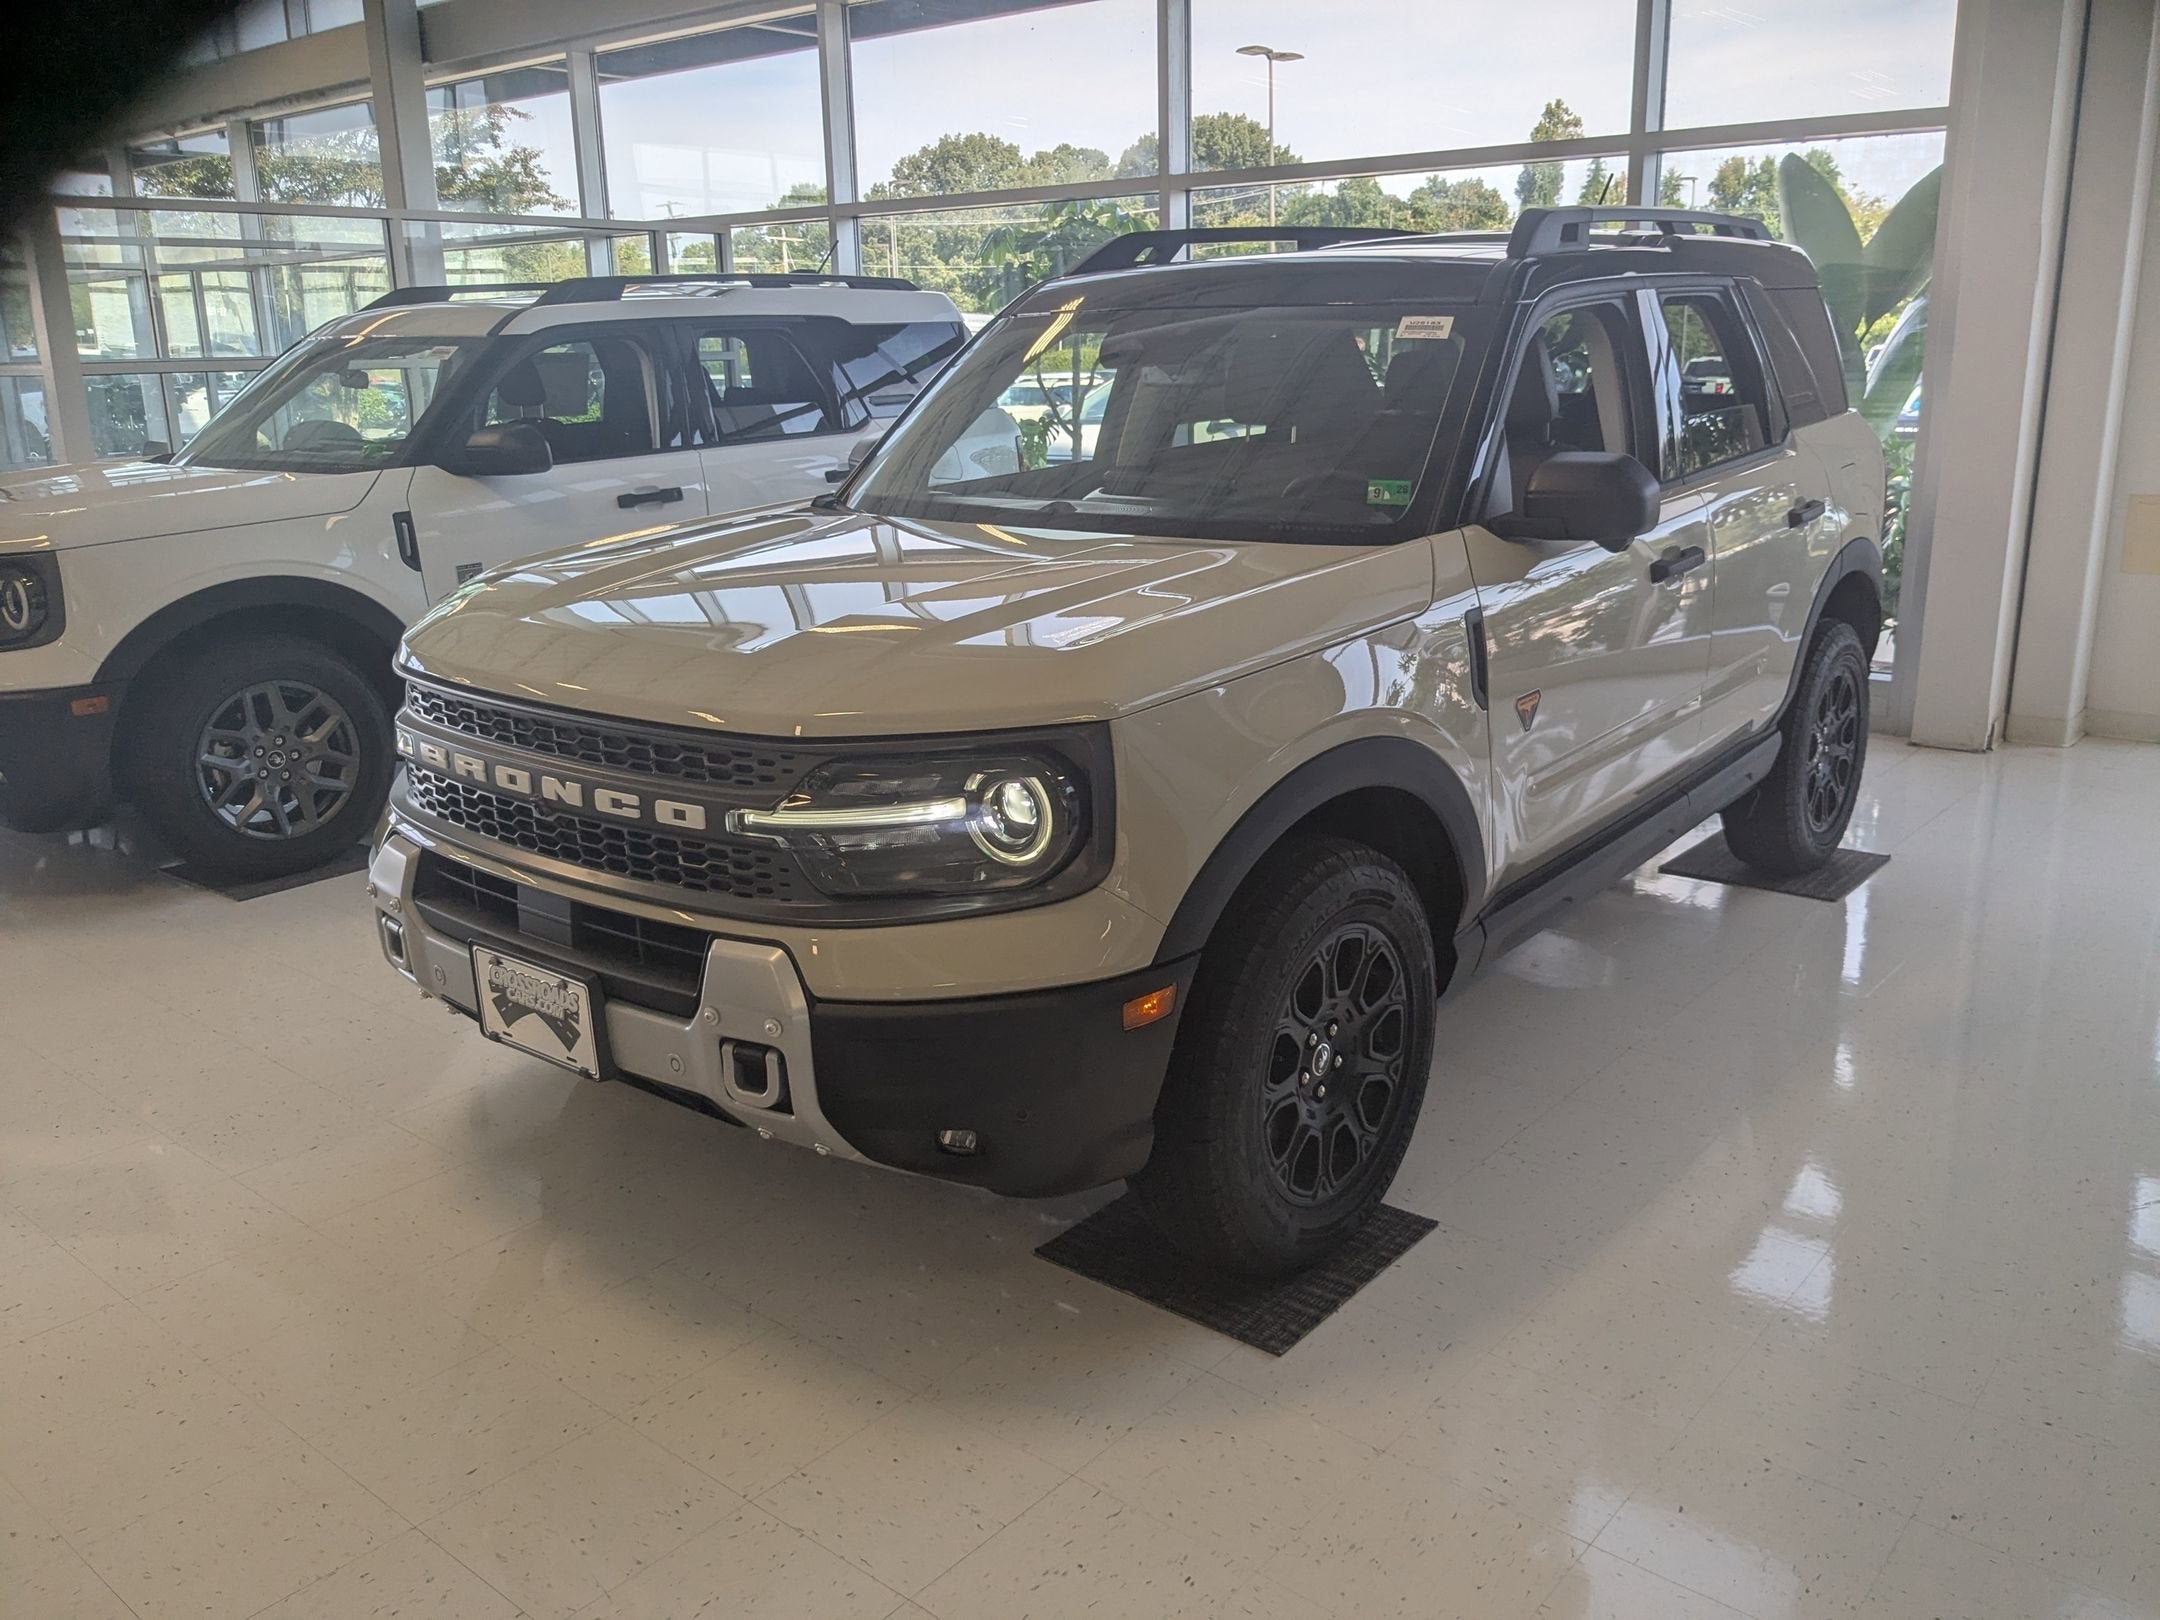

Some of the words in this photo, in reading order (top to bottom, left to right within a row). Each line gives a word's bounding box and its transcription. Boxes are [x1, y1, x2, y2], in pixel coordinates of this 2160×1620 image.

[1373, 487, 1381, 498] 9
[419, 740, 706, 830] BRONCO
[490, 963, 580, 1013] CROSSROADS
